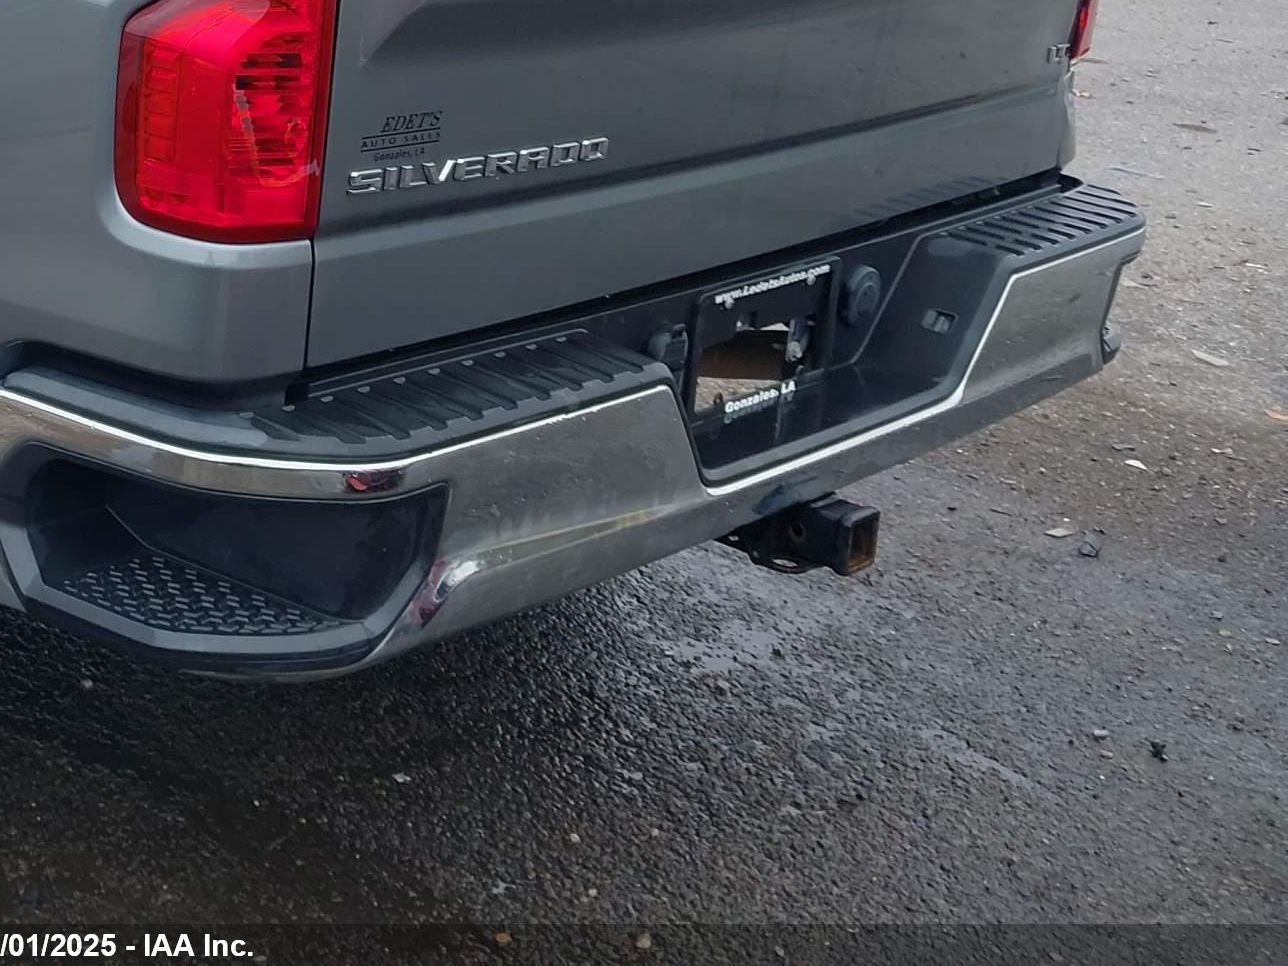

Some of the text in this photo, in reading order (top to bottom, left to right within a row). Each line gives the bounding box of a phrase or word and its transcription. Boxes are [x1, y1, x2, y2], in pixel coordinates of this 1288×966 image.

[360, 132, 441, 148] AUTO SALES
[346, 137, 609, 193] SILVERADO
[780, 379, 796, 395] LA
